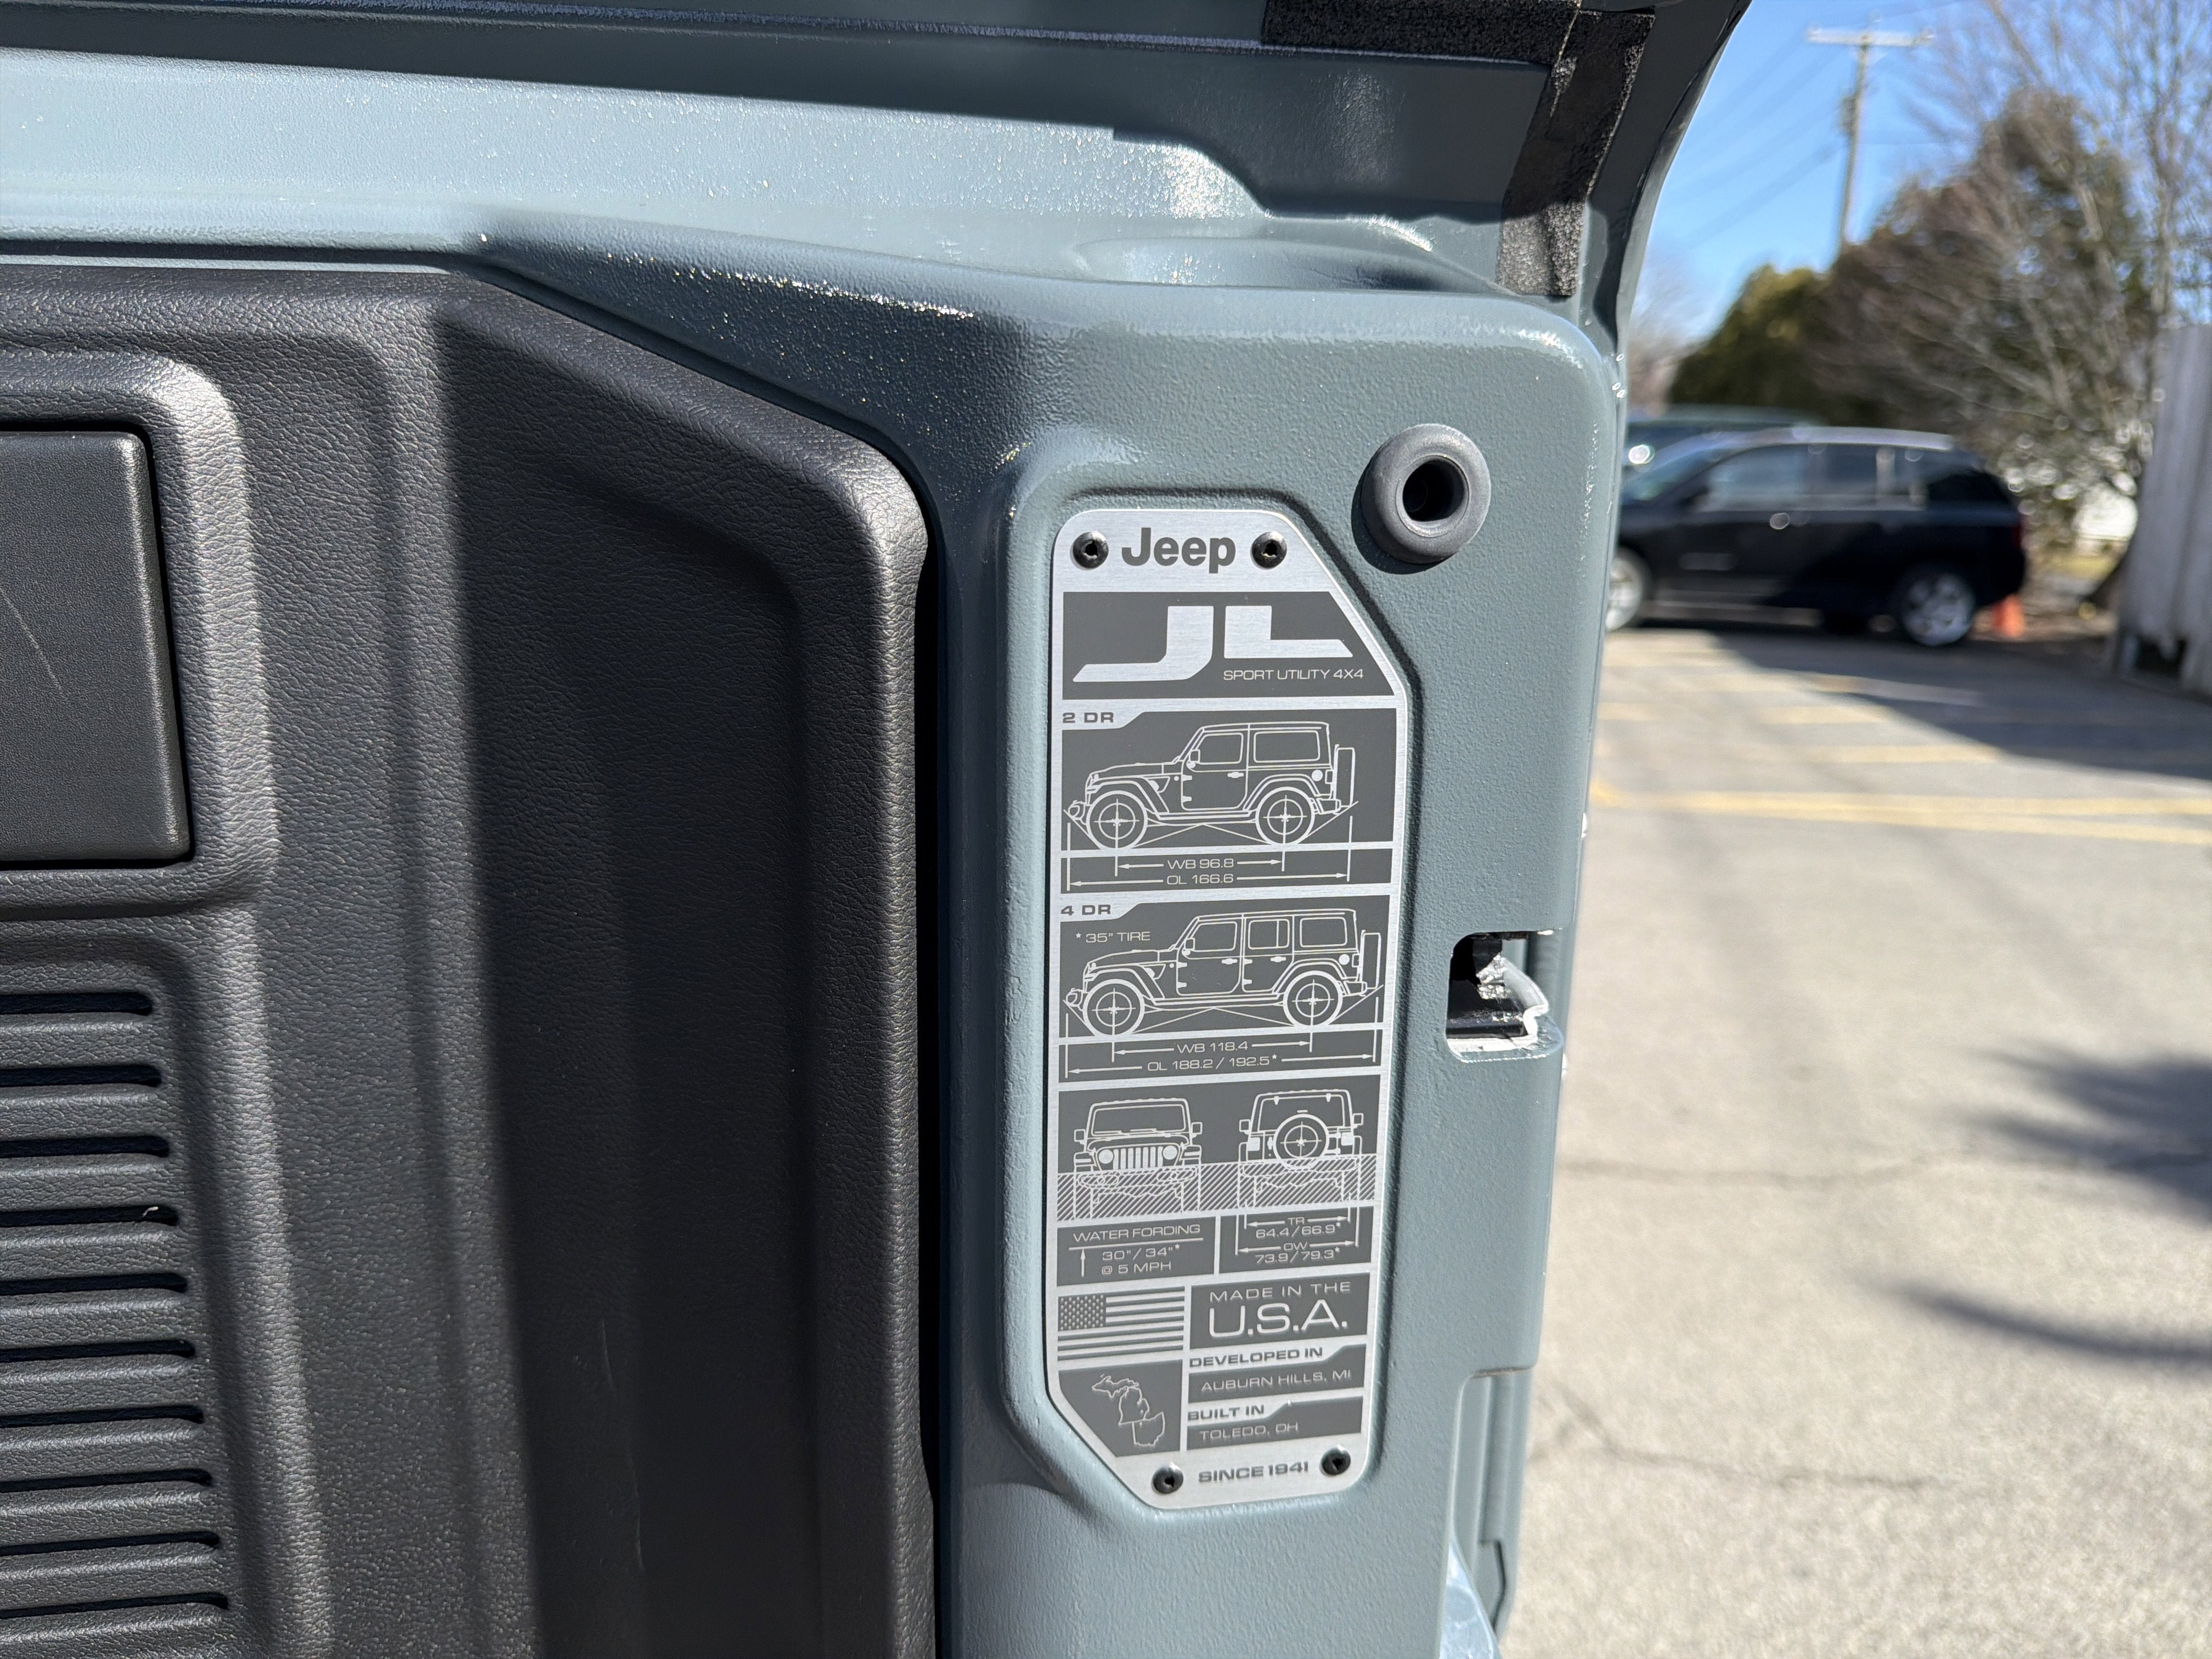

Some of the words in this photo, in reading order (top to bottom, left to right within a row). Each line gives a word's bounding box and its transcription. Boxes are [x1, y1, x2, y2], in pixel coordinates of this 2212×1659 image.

[1121, 527, 1235, 574] Jeep
[1073, 606, 1353, 682] JL
[1223, 670, 1274, 680] SPORT
[1277, 669, 1330, 680] UTILITY
[1333, 669, 1363, 679] 4X4
[1062, 712, 1075, 724] 2
[1084, 712, 1114, 724] DR
[1167, 860, 1196, 869] WB
[1199, 859, 1233, 868] 96.8
[1167, 876, 1187, 884] OL
[1192, 874, 1233, 884] 166.6
[1061, 905, 1074, 916] 4
[1082, 905, 1110, 915] DR
[1117, 932, 1150, 942] TIRE
[1177, 1043, 1205, 1053] WB
[1210, 1041, 1248, 1052] 118.4
[1148, 1062, 1167, 1071] OL
[1172, 1059, 1213, 1069] 188.2
[1288, 1217, 1305, 1225] TR
[1073, 1229, 1128, 1242] WATER
[1133, 1224, 1200, 1238] FORDING
[1284, 1242, 1308, 1251] OW
[1102, 1266, 1113, 1274] @
[1119, 1265, 1128, 1274] 5
[1134, 1261, 1171, 1273] MPH
[1210, 1287, 1273, 1302] MADE
[1282, 1285, 1301, 1296] IN
[1311, 1282, 1350, 1293] THE
[1209, 1299, 1347, 1337] U.S.A.
[1190, 1350, 1300, 1367] DEVELOPED
[1305, 1347, 1322, 1357] IN
[1201, 1376, 1273, 1391] AUBURN
[1278, 1372, 1327, 1385] HILLS,
[1333, 1369, 1350, 1380] MI
[1188, 1407, 1240, 1420] BUILT
[1246, 1405, 1264, 1415] IN
[1200, 1425, 1269, 1440] TOLEDO,
[1276, 1422, 1298, 1433] OH
[1199, 1466, 1263, 1482] SINCE
[1268, 1461, 1308, 1476] 1941
